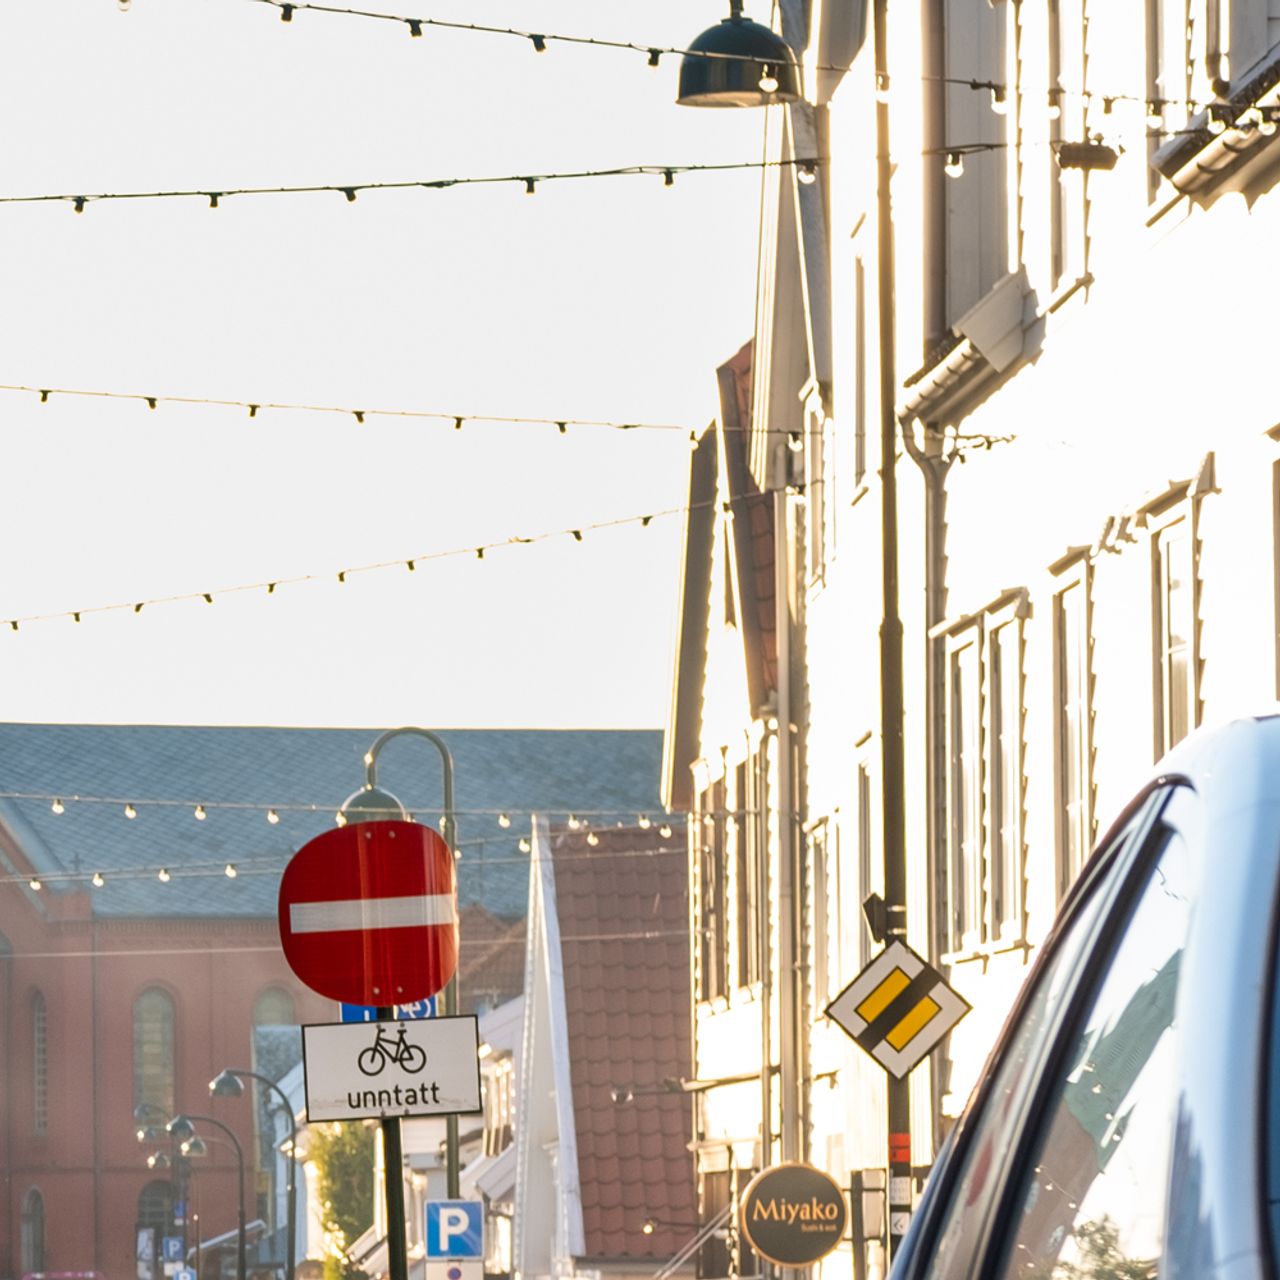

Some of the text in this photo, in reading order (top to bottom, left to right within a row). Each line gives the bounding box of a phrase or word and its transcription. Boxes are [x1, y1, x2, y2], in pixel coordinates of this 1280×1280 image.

[347, 1082, 440, 1109] unntatt
[752, 1196, 838, 1225] Miyako
[440, 1208, 469, 1251] P
